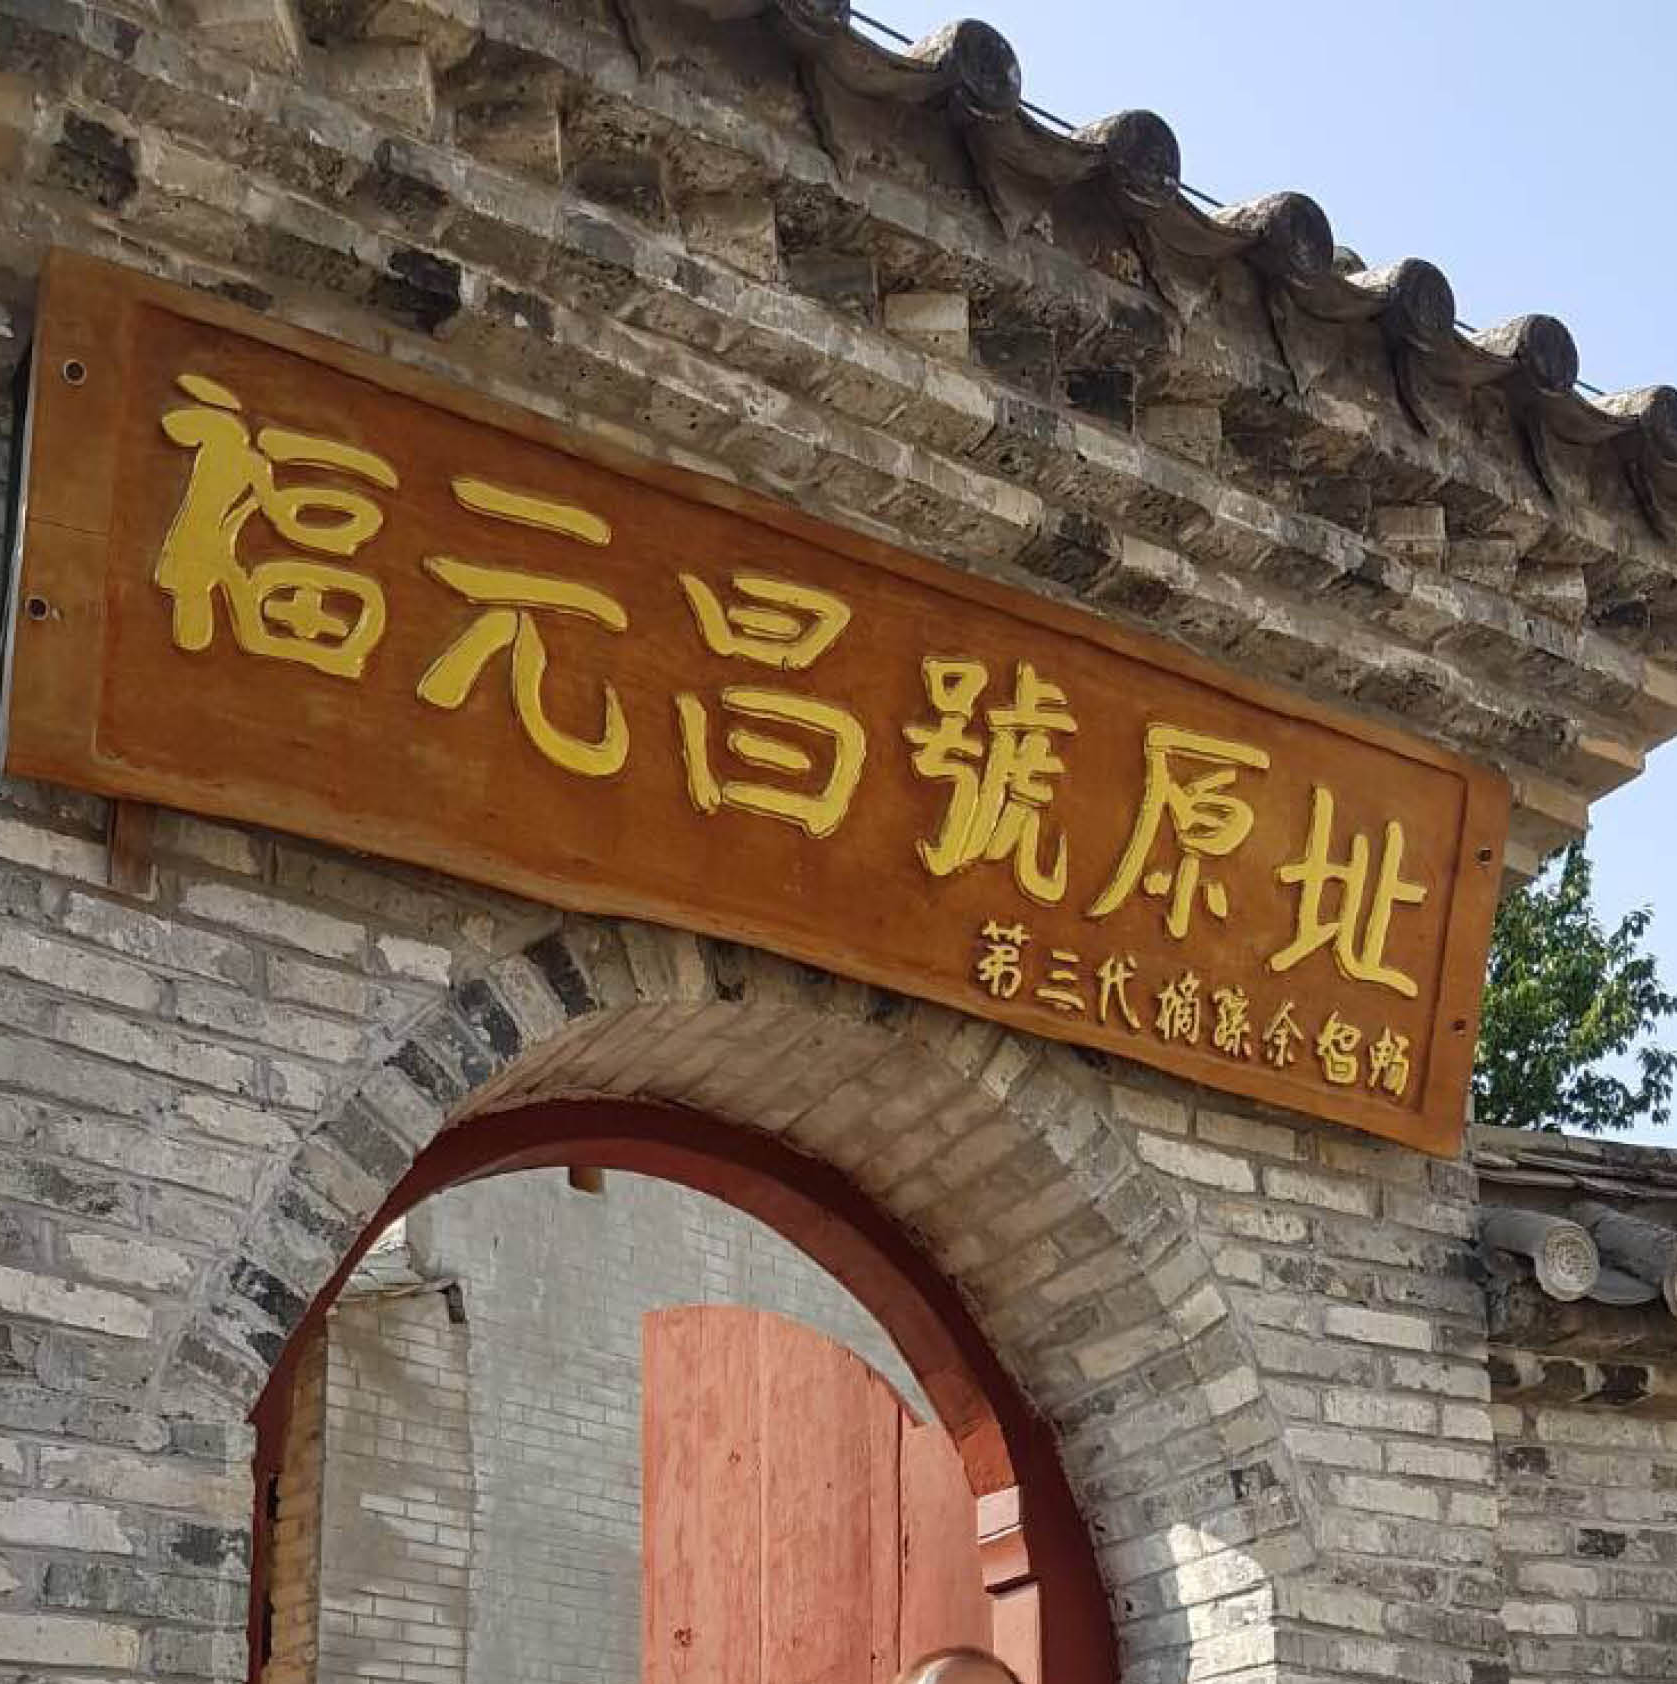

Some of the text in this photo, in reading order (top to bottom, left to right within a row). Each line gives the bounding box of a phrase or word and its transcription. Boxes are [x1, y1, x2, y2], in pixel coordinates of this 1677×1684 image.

[155, 373, 1429, 998] 福元昌號原址
